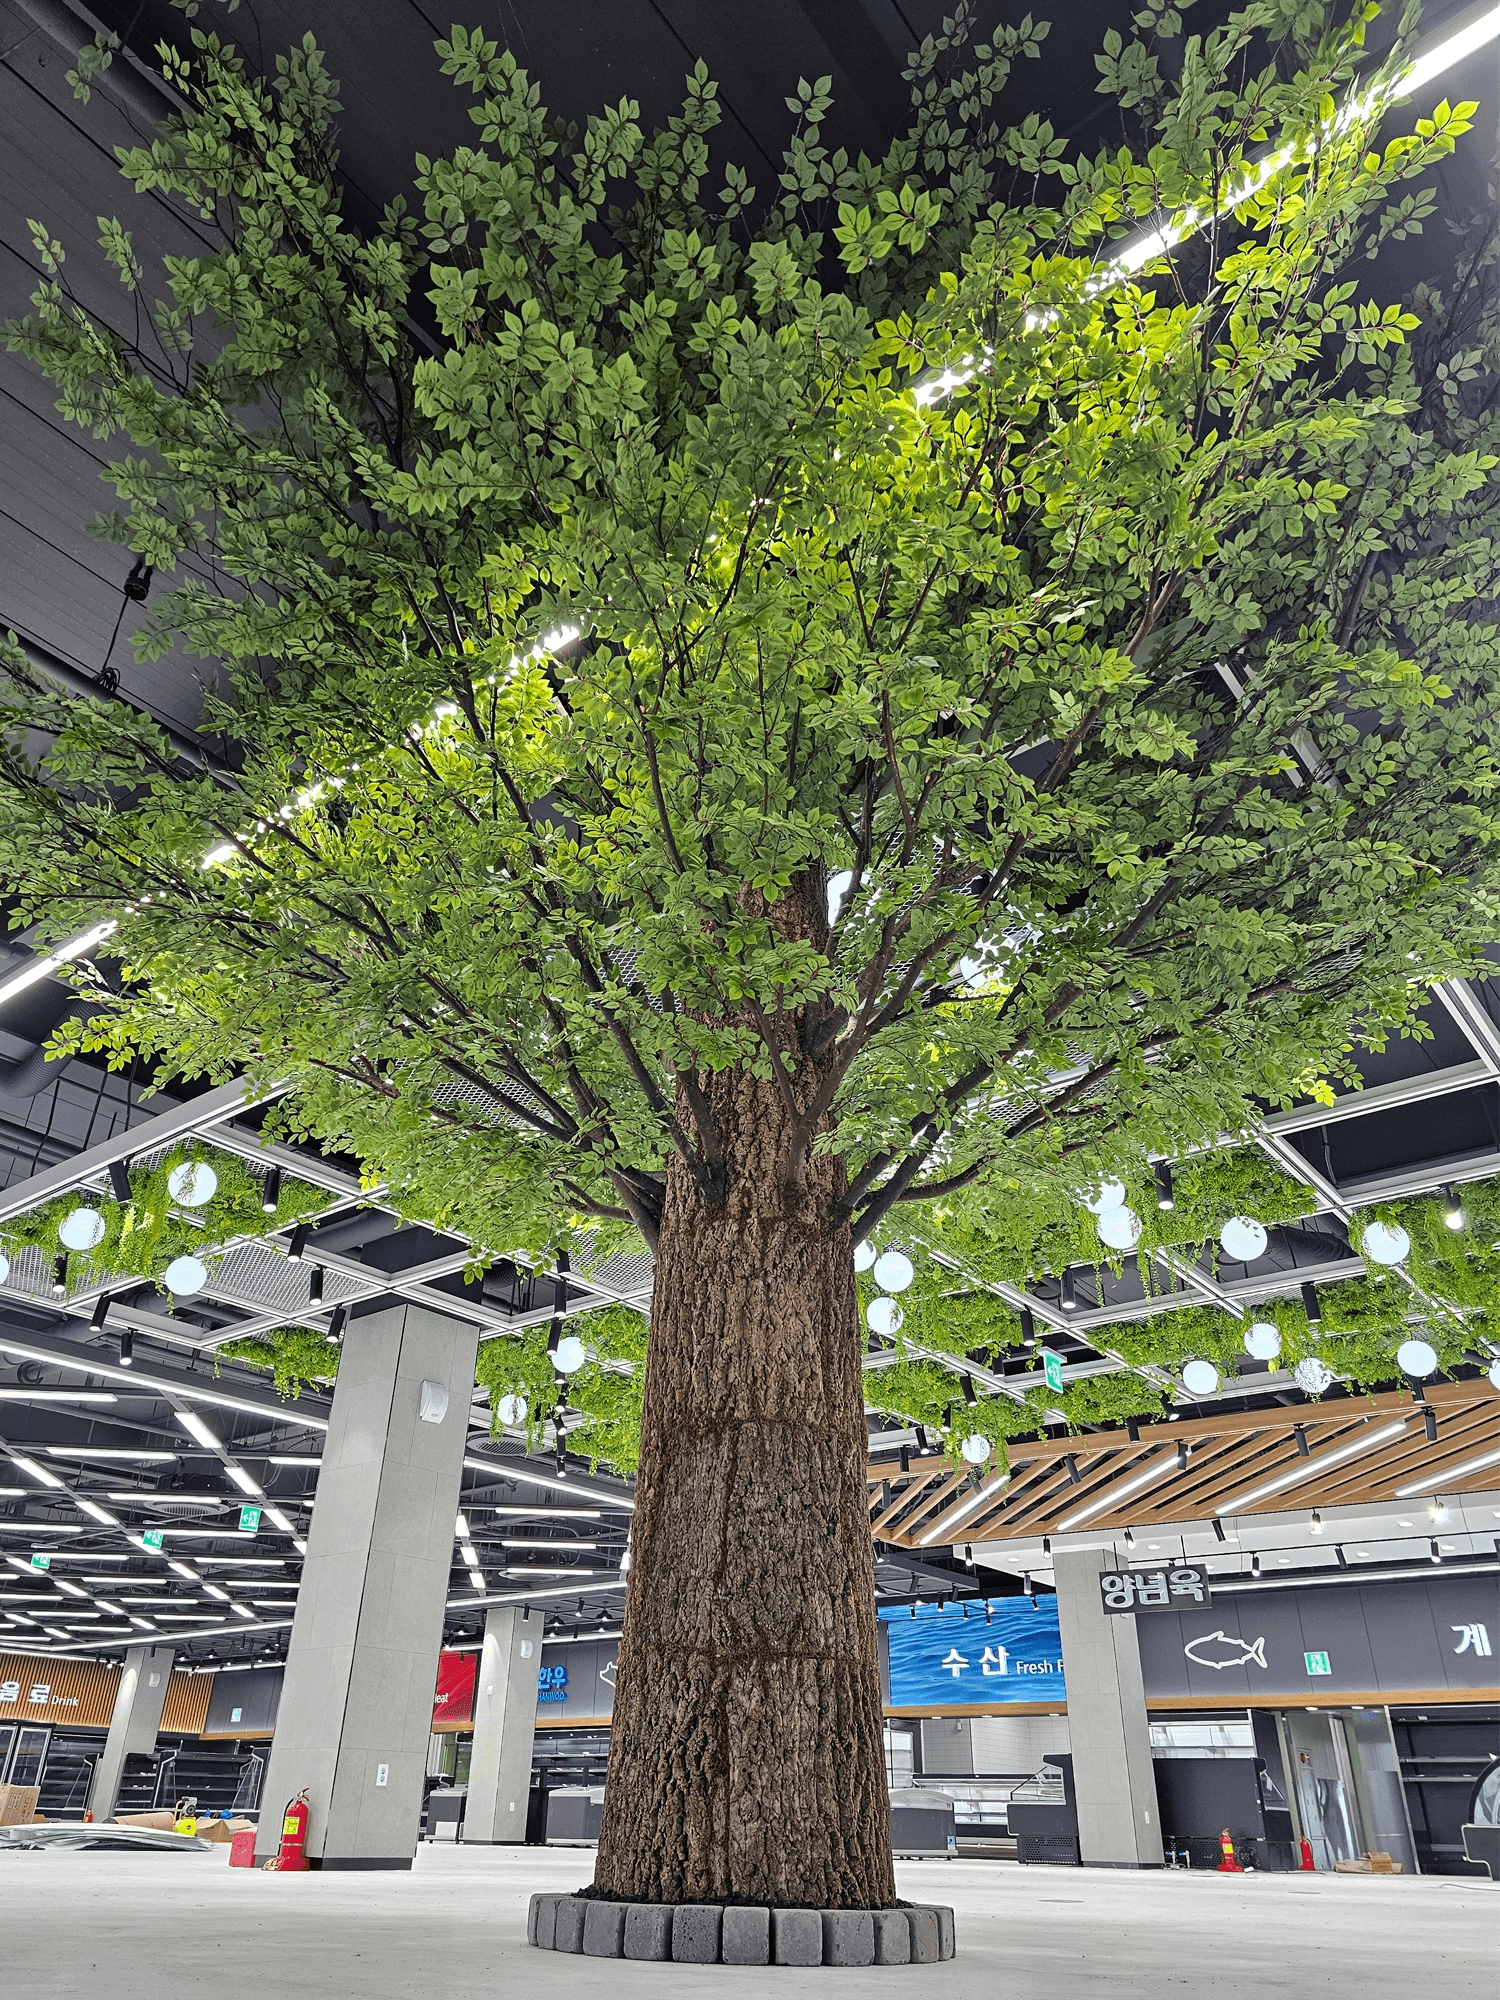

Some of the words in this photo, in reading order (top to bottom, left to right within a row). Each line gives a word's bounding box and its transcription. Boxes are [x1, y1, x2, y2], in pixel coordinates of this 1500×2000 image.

[1101, 1569, 1204, 1608] 양념육
[1449, 1623, 1492, 1656] 계
[1016, 1659, 1053, 1675] Fresh
[538, 1665, 568, 1690] 한우
[51, 1695, 79, 1707] Drink
[435, 1693, 448, 1704] eat
